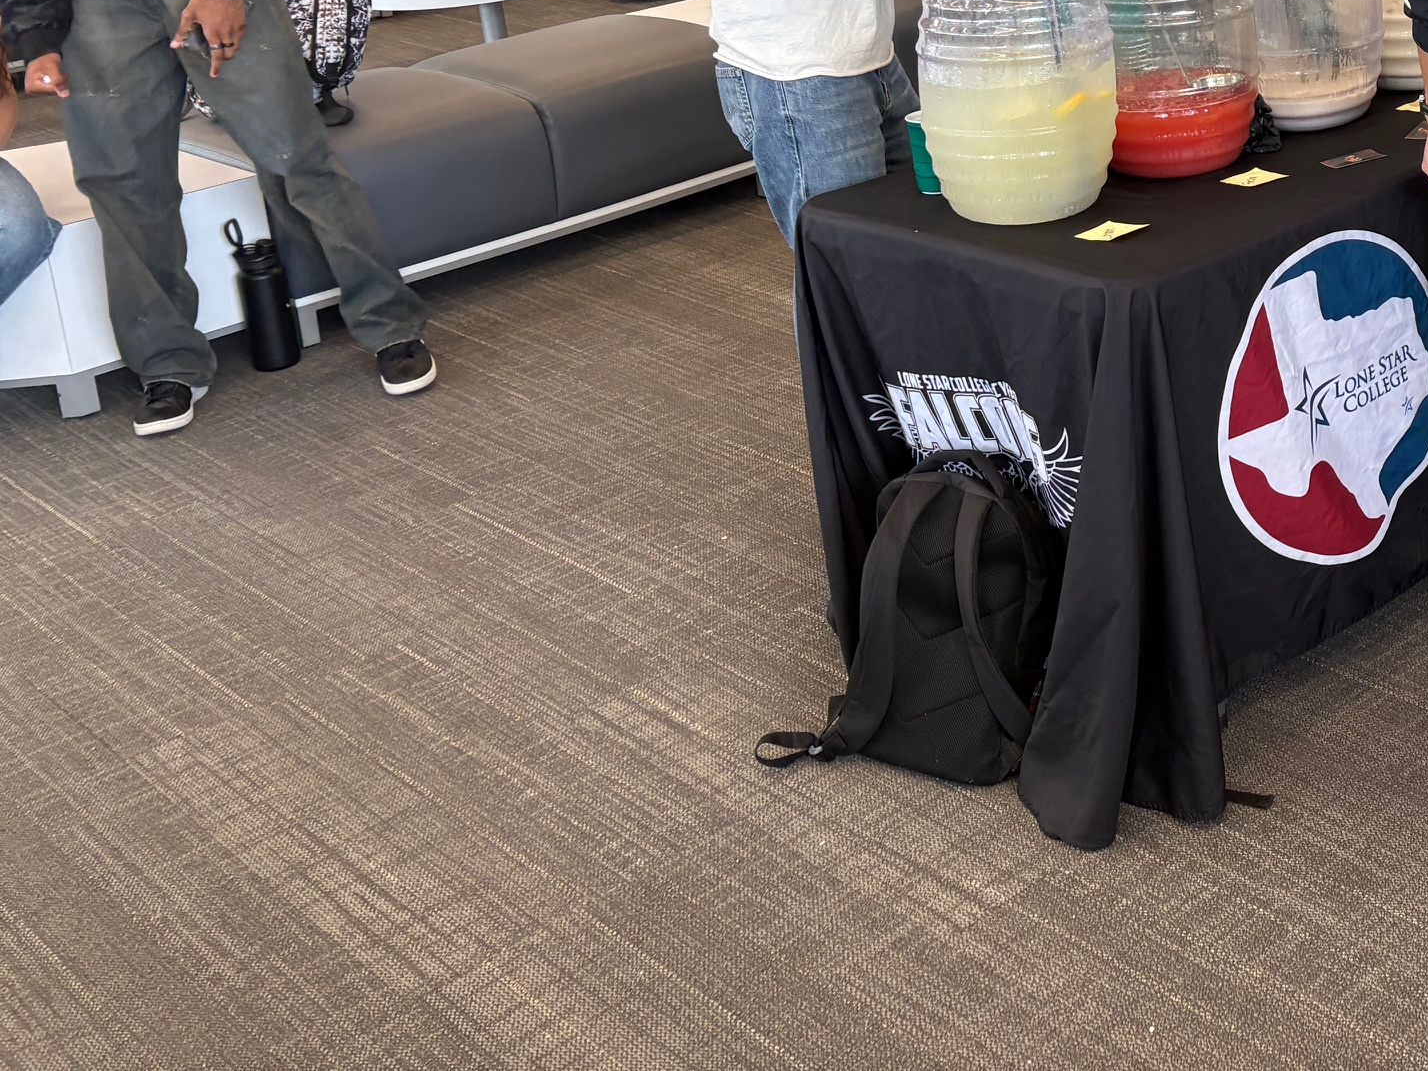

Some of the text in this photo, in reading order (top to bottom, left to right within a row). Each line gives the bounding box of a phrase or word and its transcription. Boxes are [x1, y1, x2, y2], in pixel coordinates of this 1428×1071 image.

[896, 370, 924, 389] LONE
[922, 375, 951, 390] STAR
[1333, 344, 1418, 400] LONE STAR
[1343, 366, 1408, 413] COLLEGE
